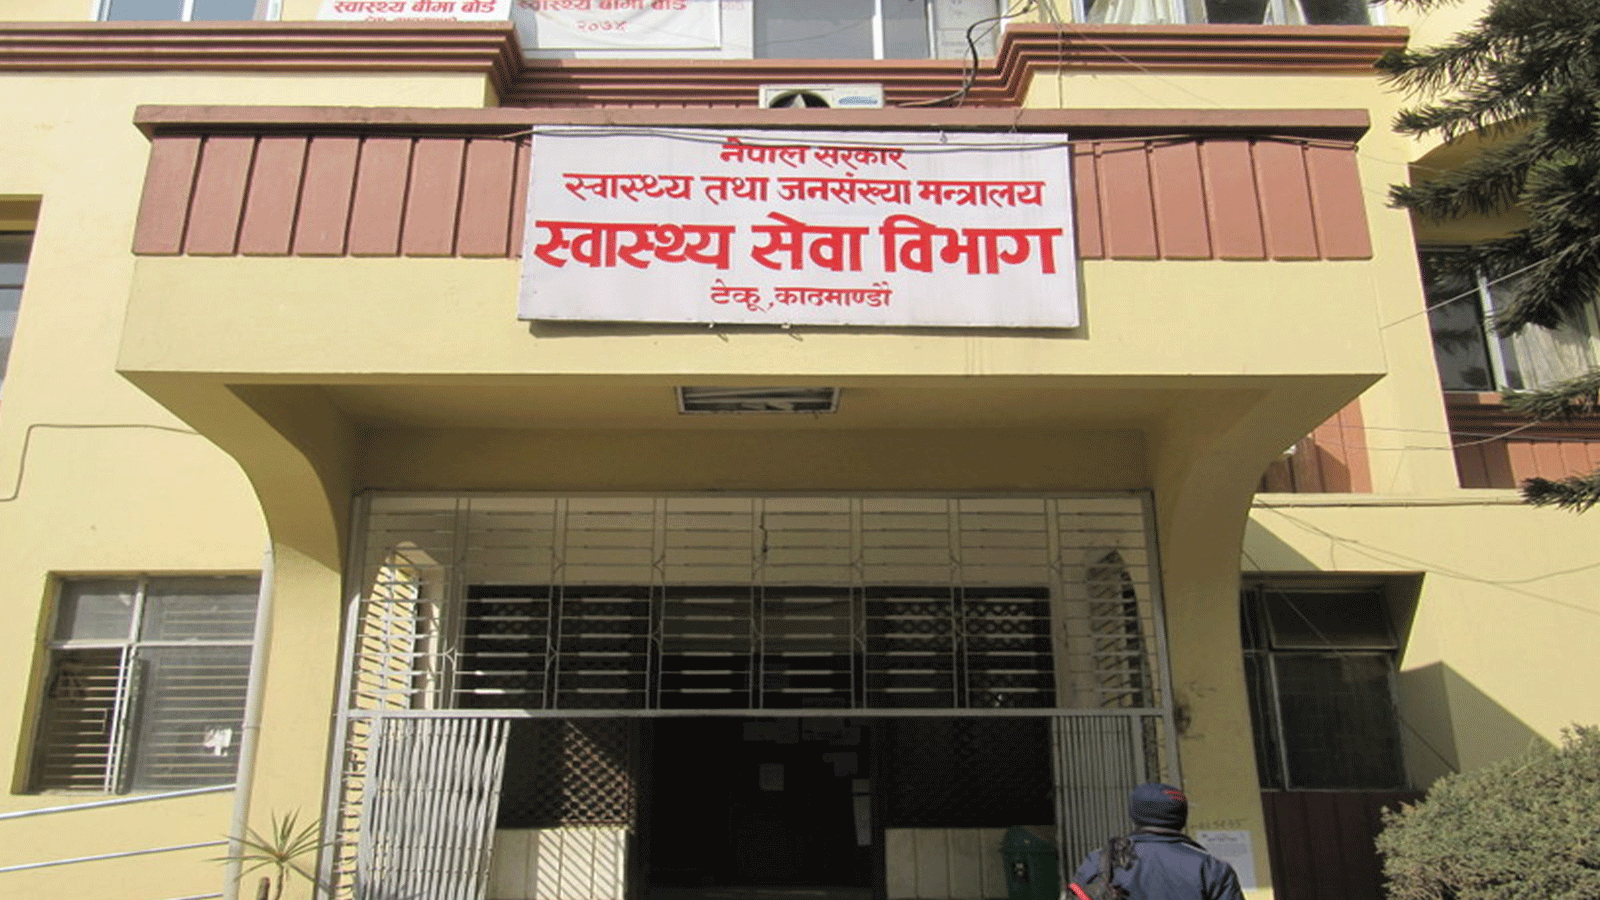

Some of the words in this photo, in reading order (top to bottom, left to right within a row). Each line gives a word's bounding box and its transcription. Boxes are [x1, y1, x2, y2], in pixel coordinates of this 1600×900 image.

[719, 136, 811, 168] नेपाल
[813, 145, 908, 170] सरकार
[562, 173, 695, 202] स्वास्थ्य
[700, 176, 770, 205] तथा
[777, 172, 911, 205] जनसंख्या
[917, 180, 1046, 207] मन्त्रालय
[533, 220, 736, 270] स्वास्थ्य
[750, 211, 870, 272] सेवा
[877, 214, 1064, 275] विभाग
